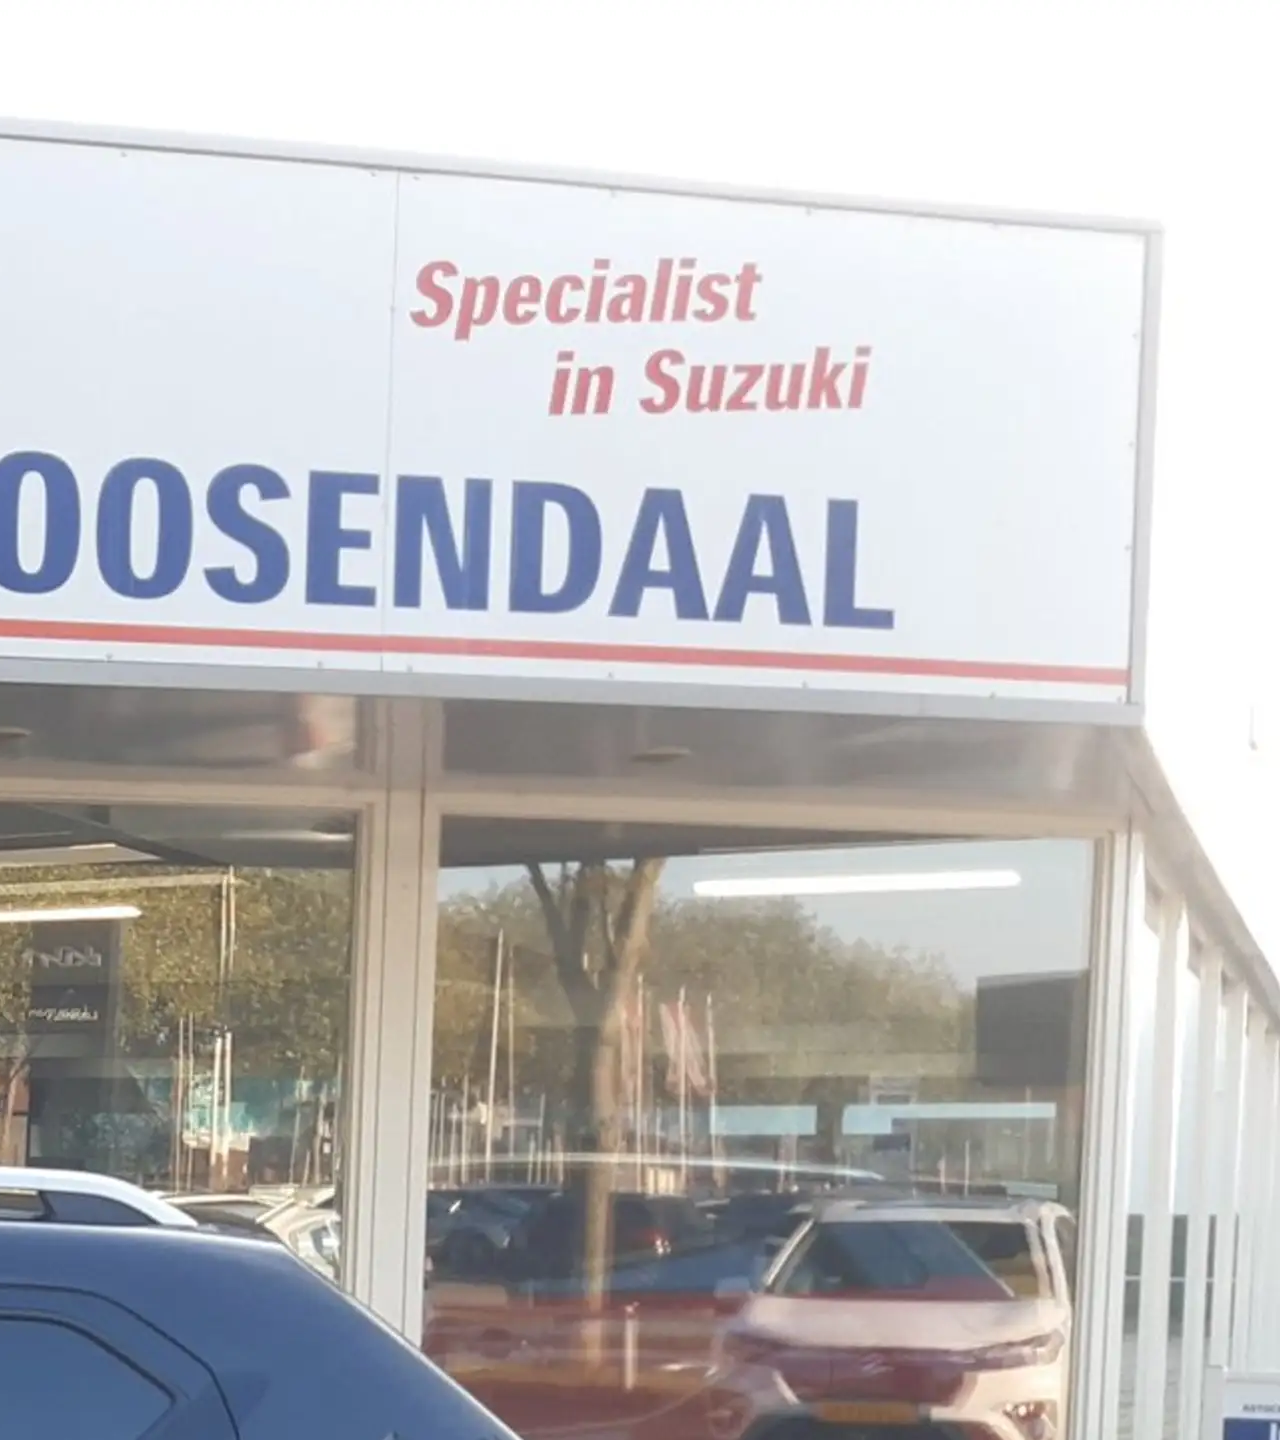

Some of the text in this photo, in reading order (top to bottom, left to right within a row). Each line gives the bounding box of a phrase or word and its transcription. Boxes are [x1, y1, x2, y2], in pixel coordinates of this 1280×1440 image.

[409, 257, 764, 342] Specialist
[547, 345, 873, 417] in Suzuki
